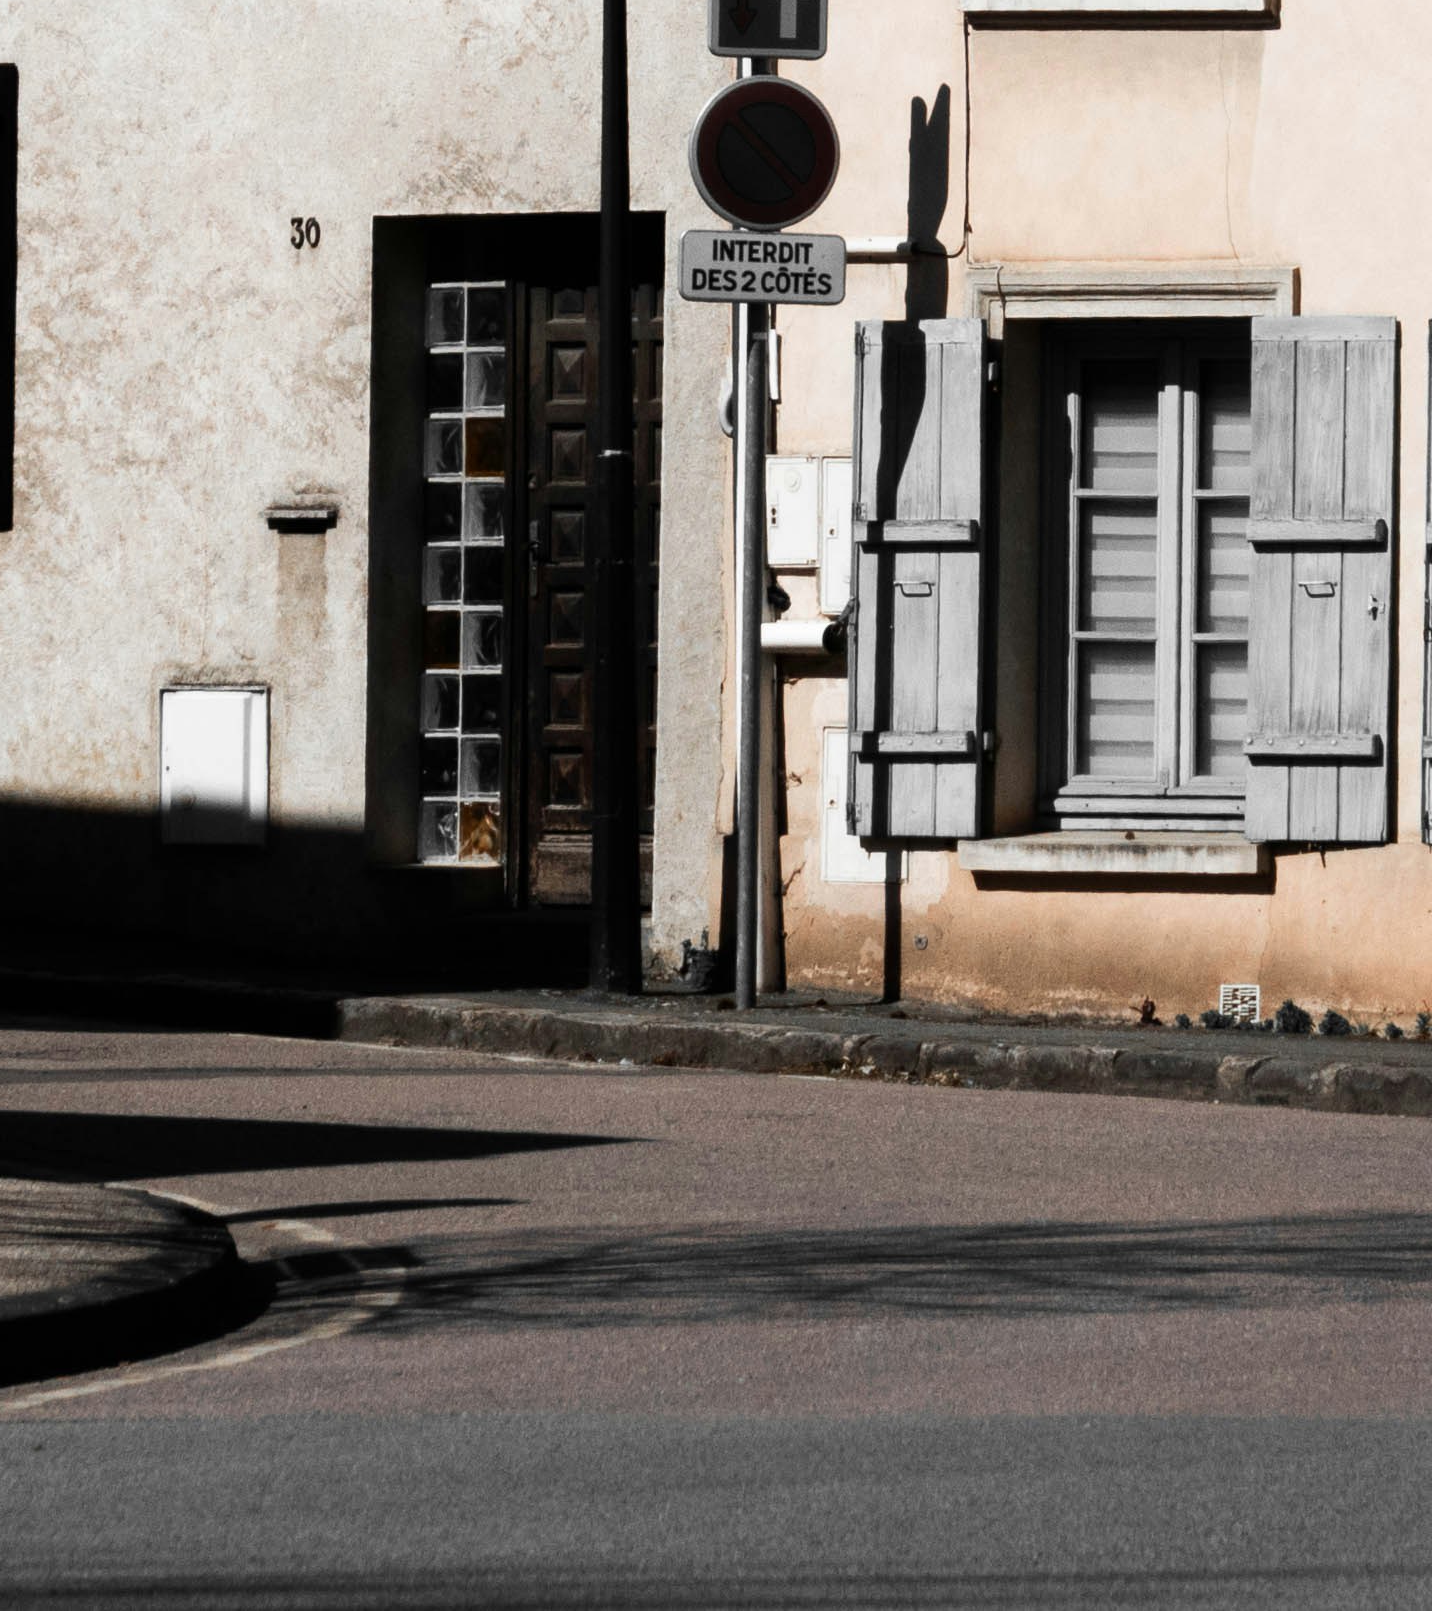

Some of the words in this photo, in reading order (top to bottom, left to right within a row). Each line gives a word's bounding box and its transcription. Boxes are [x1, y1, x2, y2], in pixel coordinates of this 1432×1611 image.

[290, 216, 321, 250] 30
[712, 238, 814, 265] INTERDIT
[691, 267, 738, 292] DES
[741, 269, 756, 293] 2
[760, 266, 833, 296] CÔTÉS
